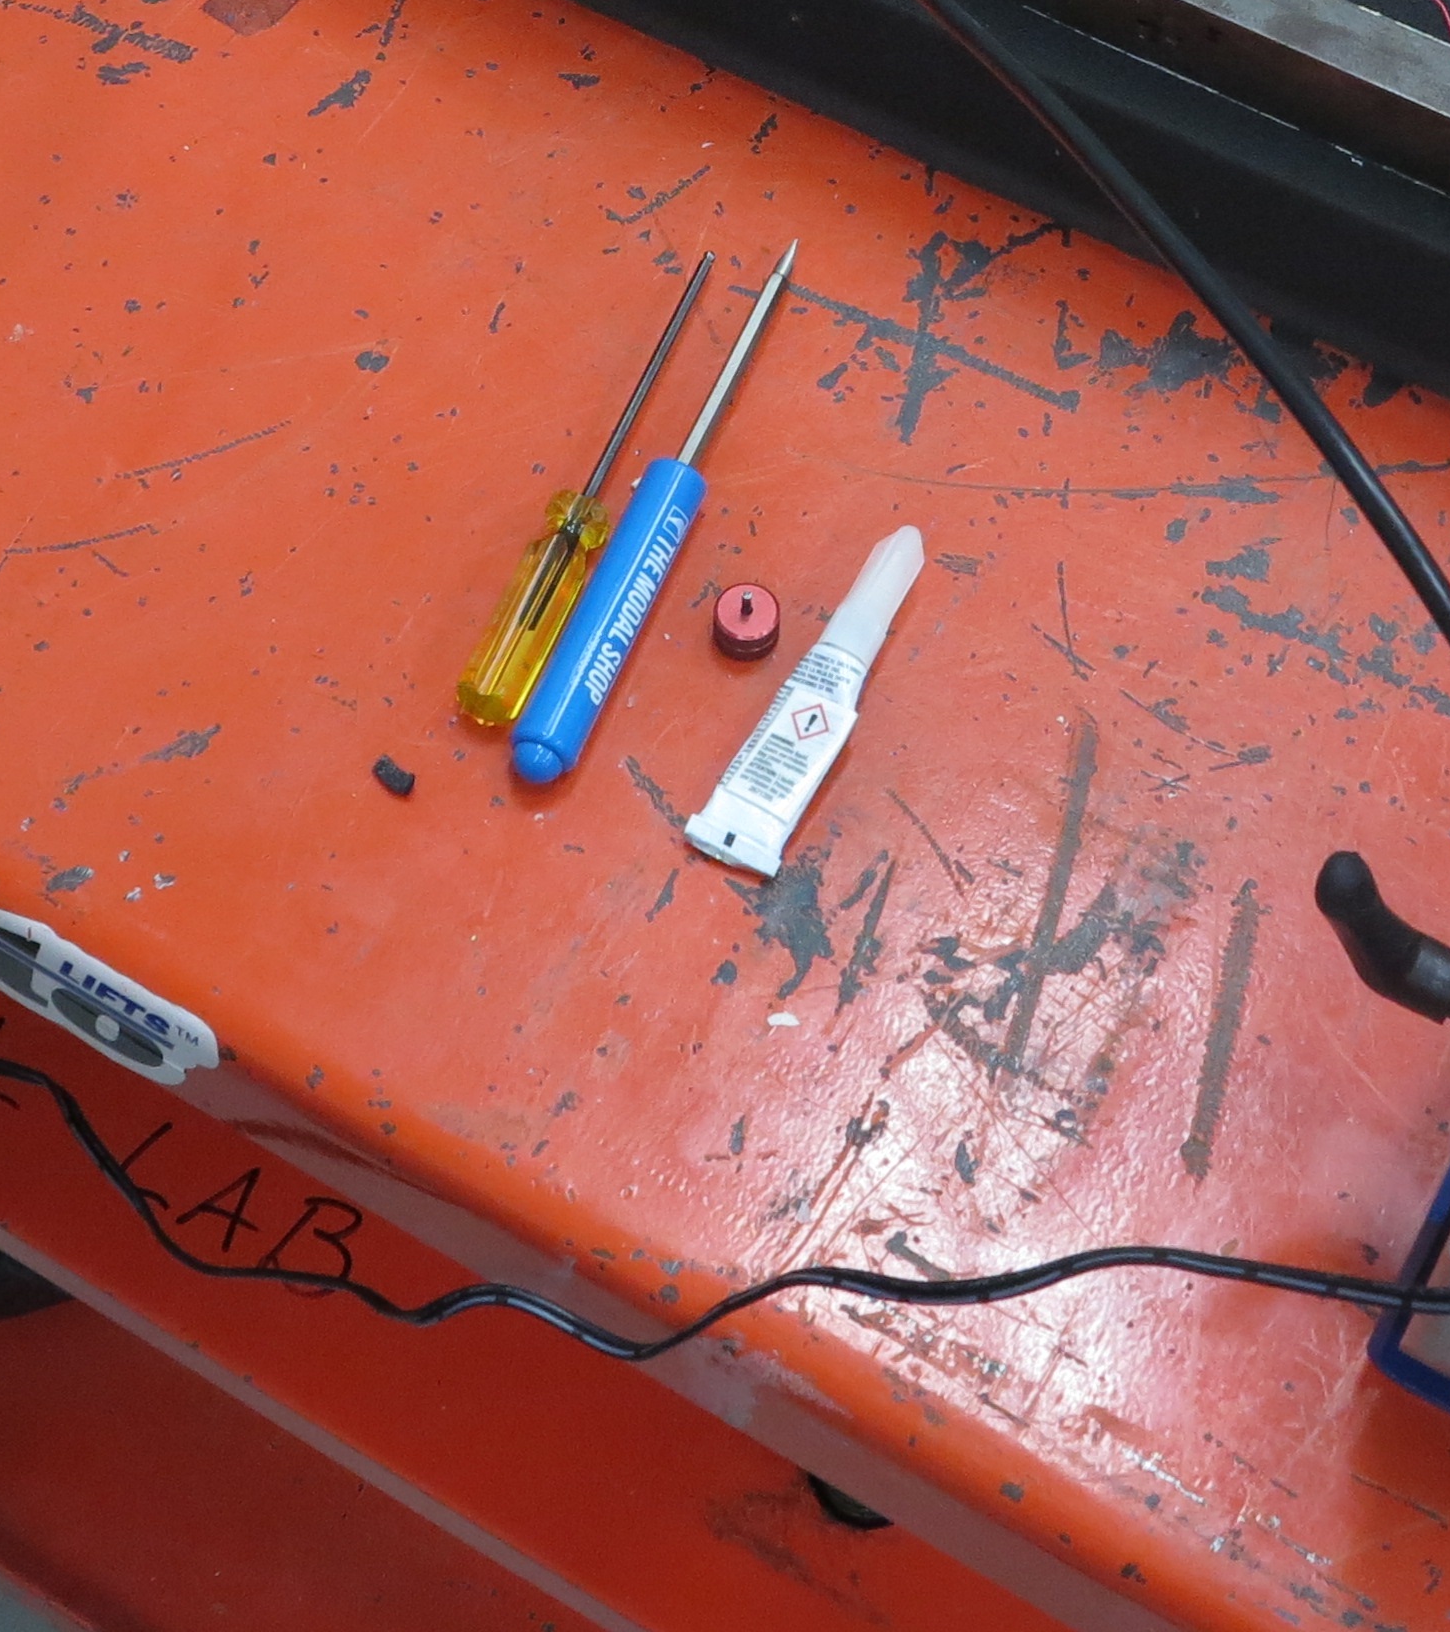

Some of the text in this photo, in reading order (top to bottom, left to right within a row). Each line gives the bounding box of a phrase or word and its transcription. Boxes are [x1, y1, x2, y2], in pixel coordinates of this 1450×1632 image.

[584, 534, 677, 707] THE MODAL SHOP
[59, 960, 171, 1037] LIFTS
[116, 1120, 364, 1295] LAB
